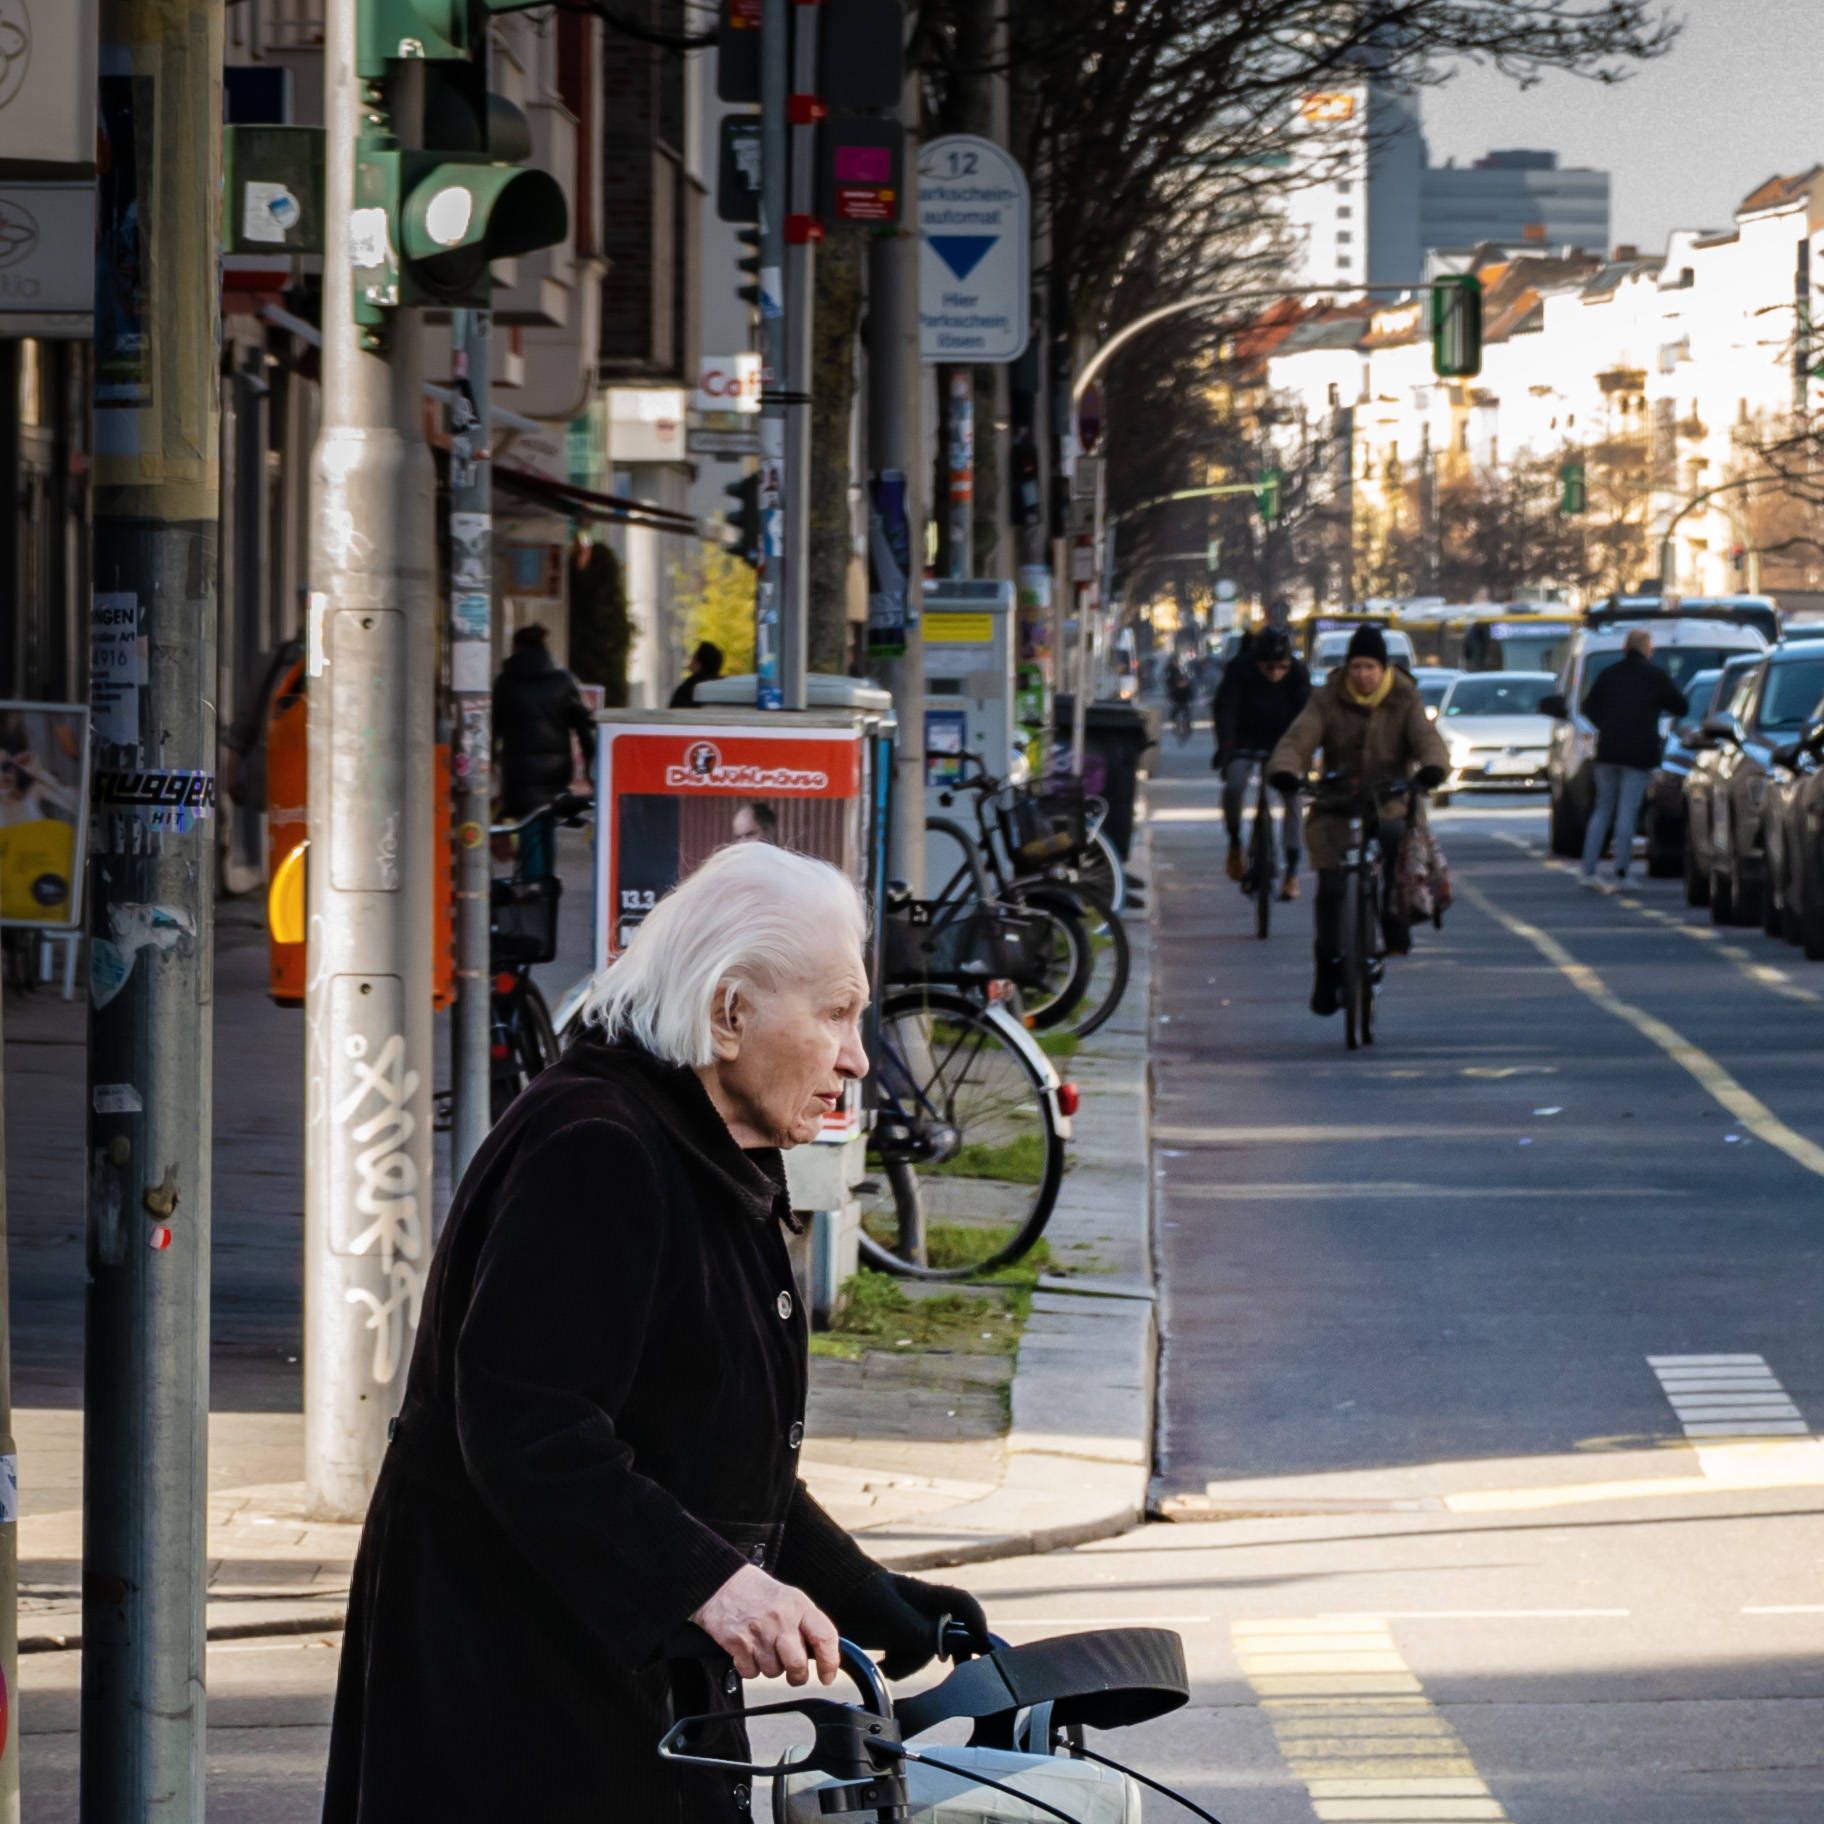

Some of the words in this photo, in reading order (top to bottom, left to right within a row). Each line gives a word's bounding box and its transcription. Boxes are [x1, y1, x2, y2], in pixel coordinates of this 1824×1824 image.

[948, 152, 979, 175] 12
[919, 186, 1021, 202] arkschein-
[924, 210, 1000, 225] automat
[943, 292, 979, 308] Hier
[936, 333, 986, 350] lösen
[669, 767, 705, 784] Die
